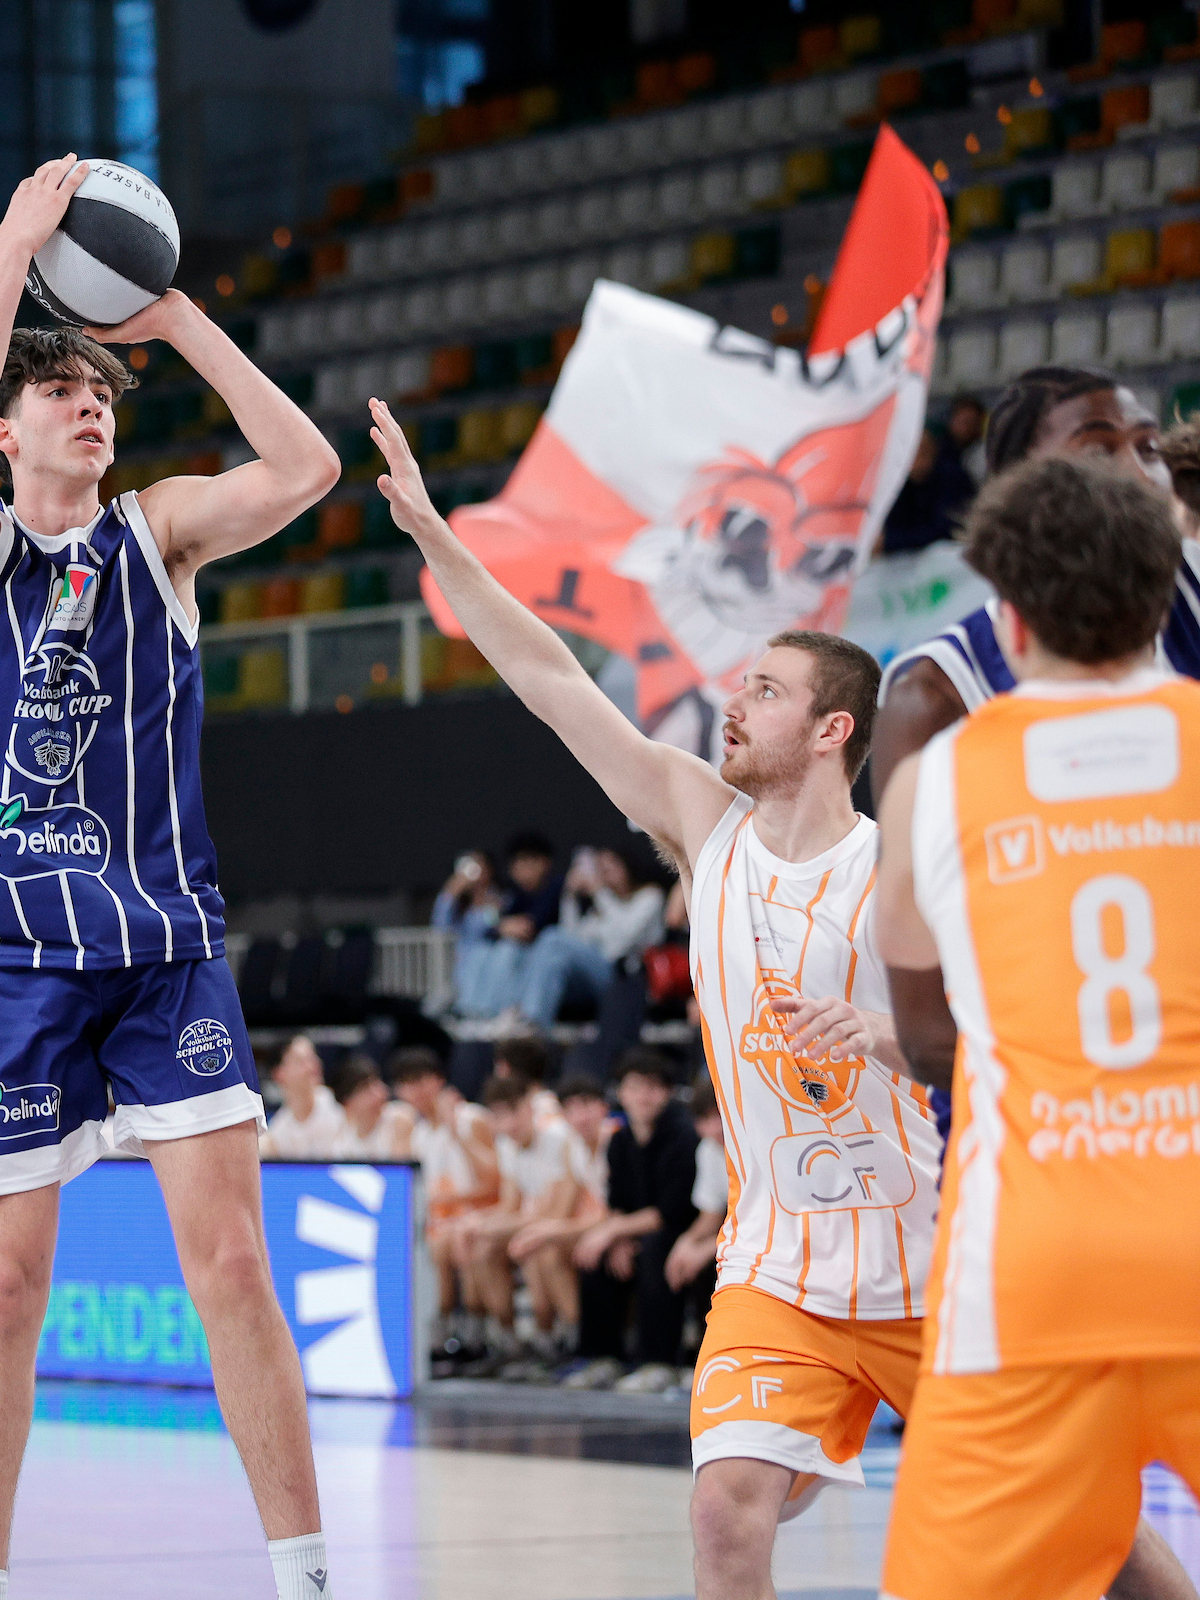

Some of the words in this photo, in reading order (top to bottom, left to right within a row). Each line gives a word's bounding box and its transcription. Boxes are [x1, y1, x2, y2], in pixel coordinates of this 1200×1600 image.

[92, 166, 151, 201] BASKET
[14, 698, 65, 722] HOOL
[68, 694, 112, 717] CUP
[1070, 870, 1162, 1071] 8
[175, 1041, 216, 1059] SCHOOL
[186, 1032, 221, 1047] Volksbank
